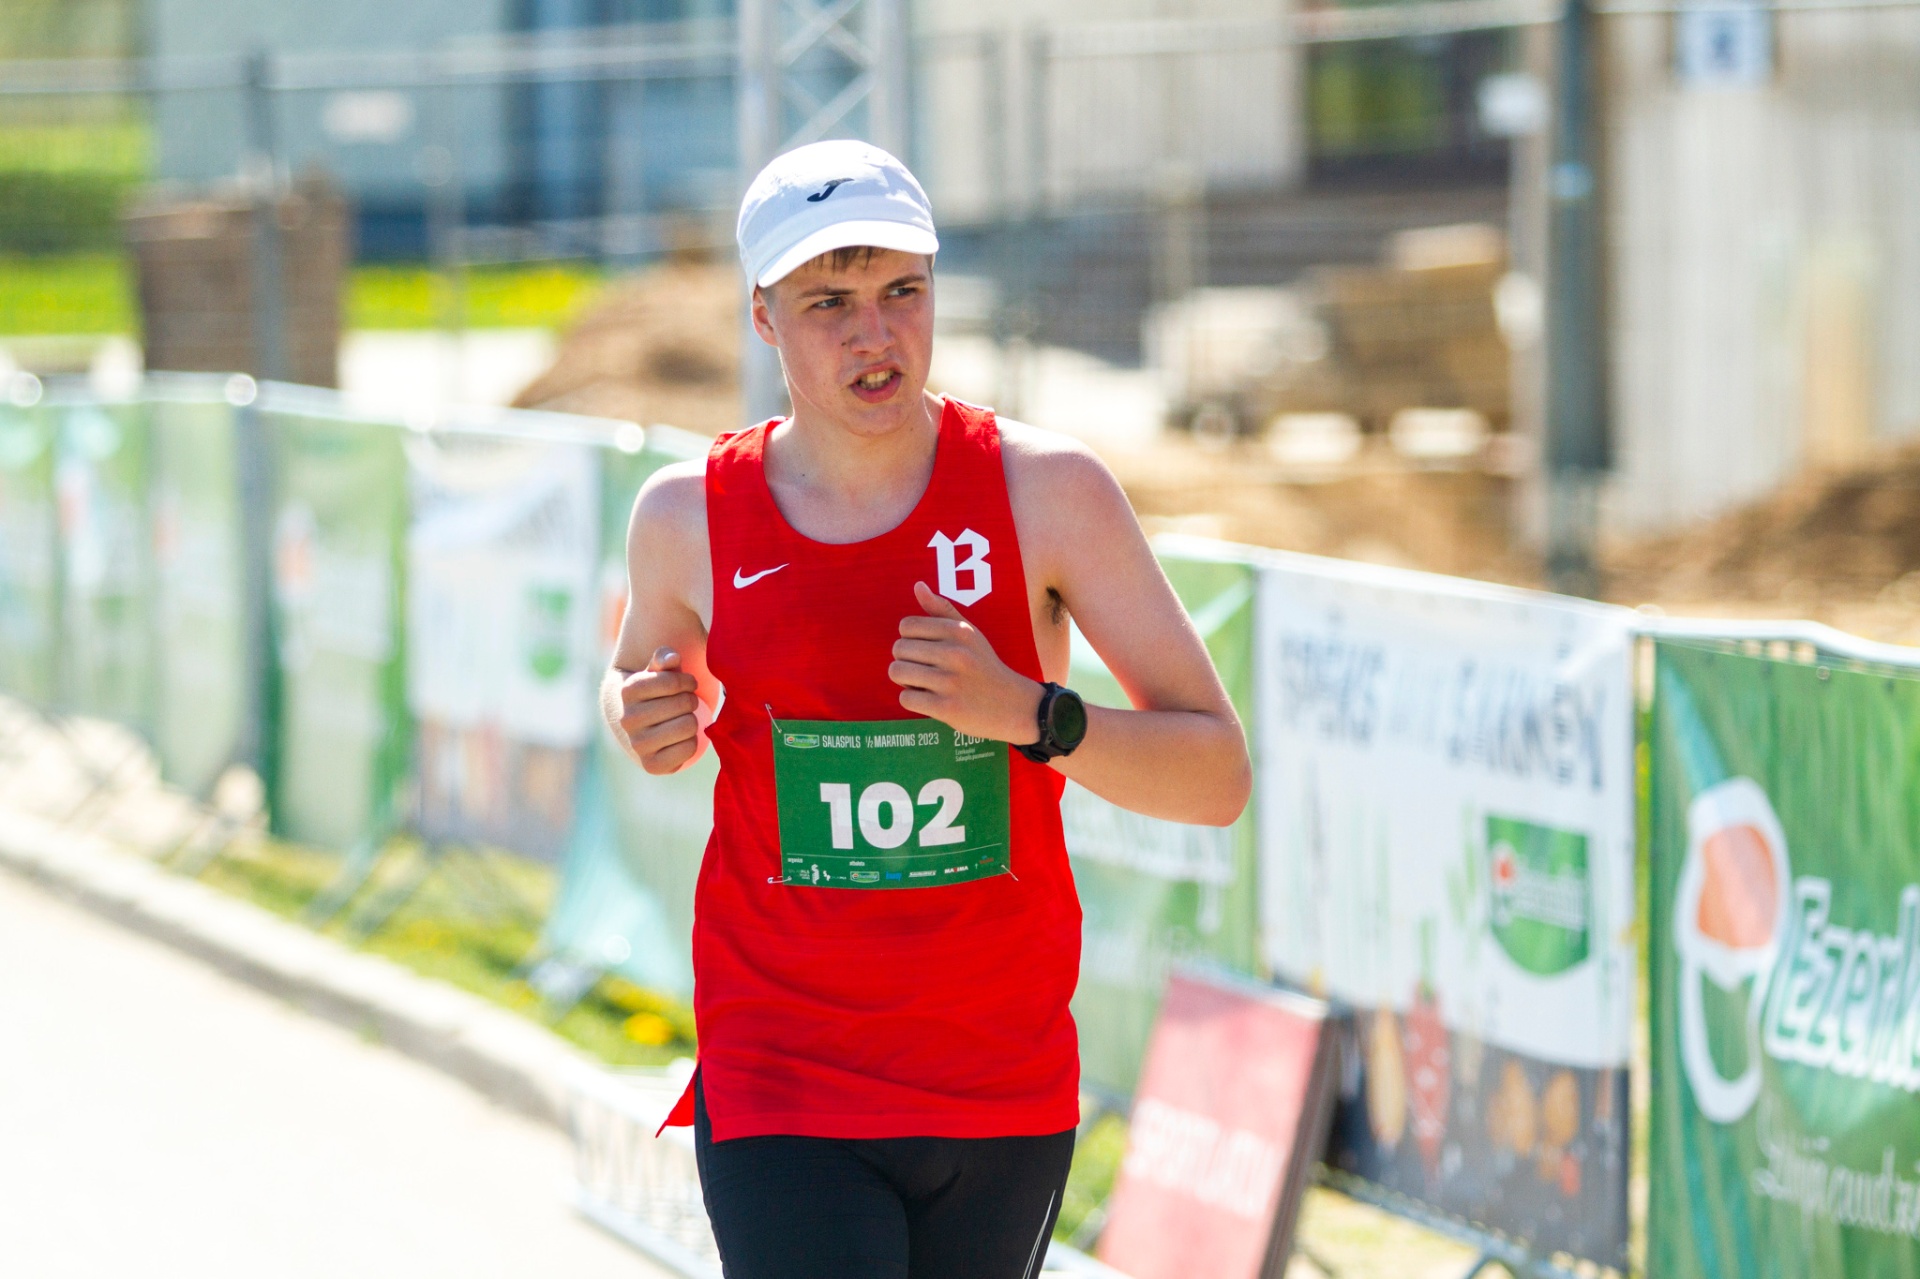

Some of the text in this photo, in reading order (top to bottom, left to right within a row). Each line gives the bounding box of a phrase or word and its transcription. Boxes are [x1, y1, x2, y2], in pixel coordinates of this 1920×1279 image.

[926, 527, 993, 608] B
[822, 734, 861, 749] SALASPILS
[918, 732, 940, 746] 2023
[819, 778, 966, 850] 102
